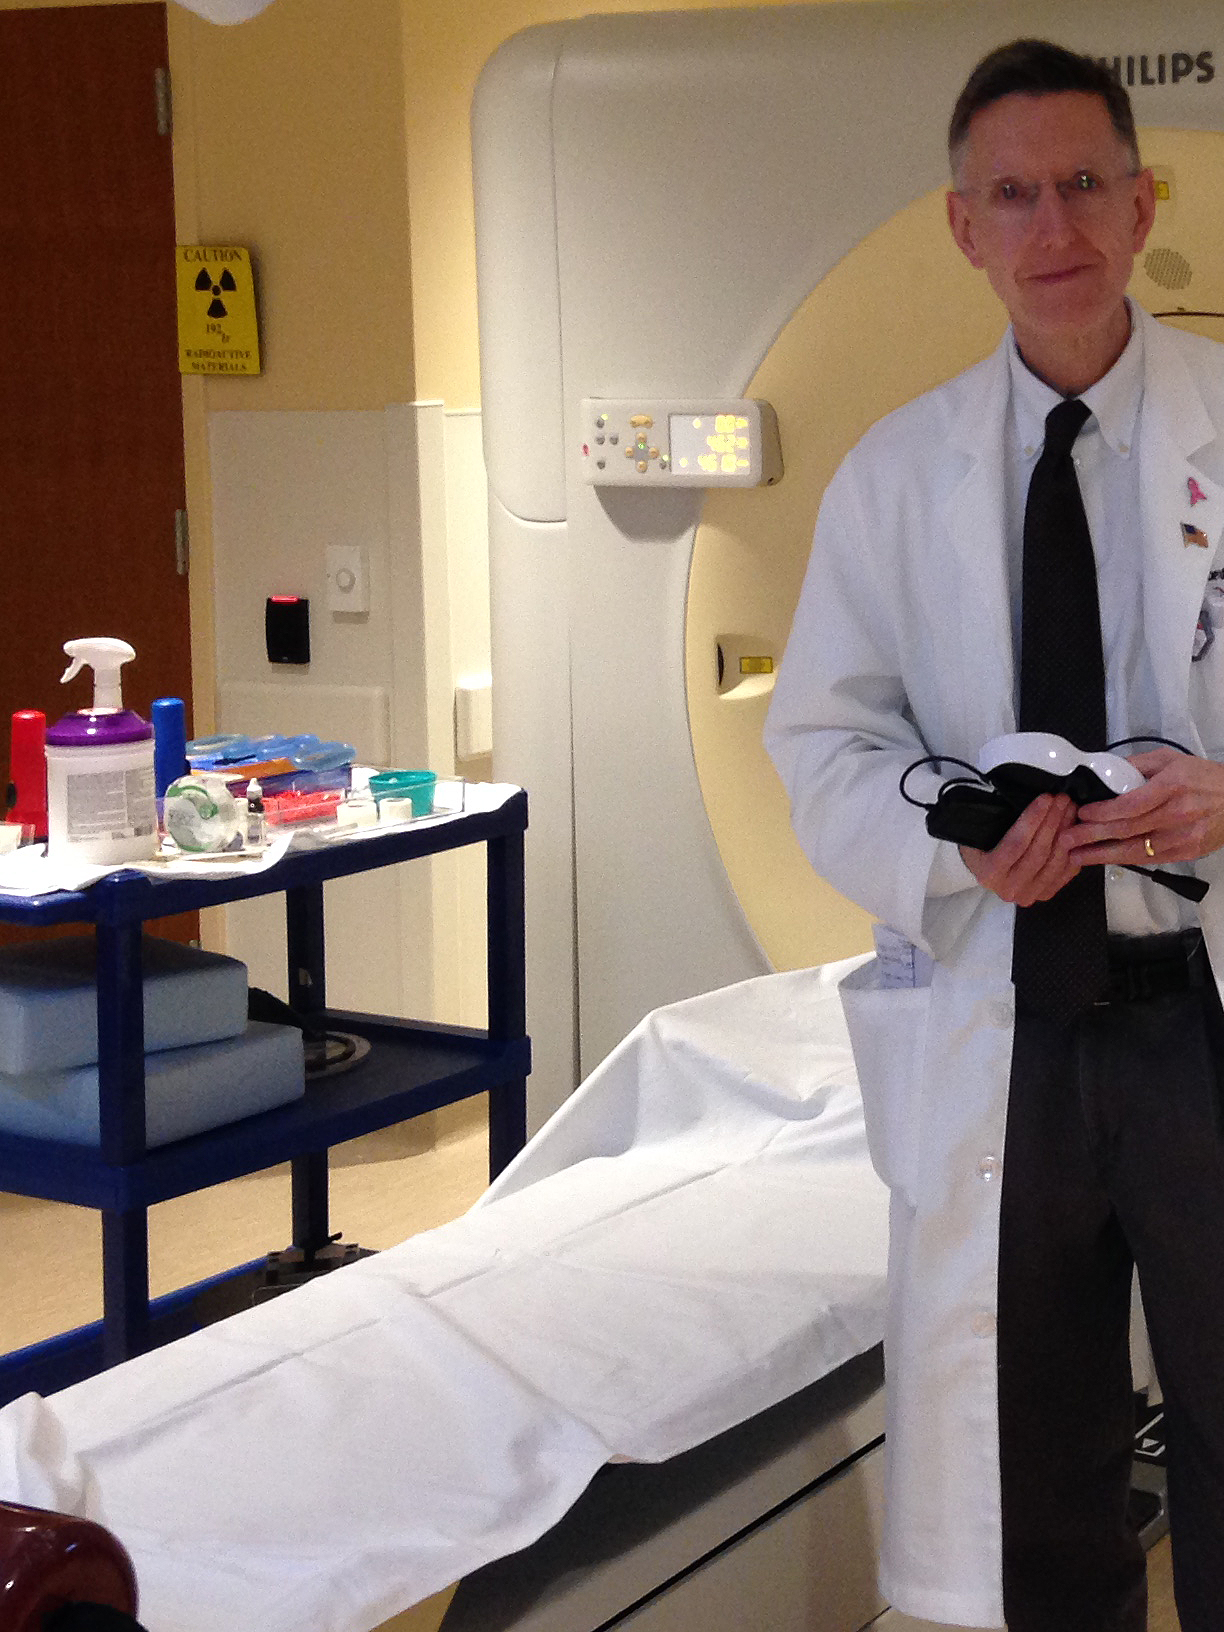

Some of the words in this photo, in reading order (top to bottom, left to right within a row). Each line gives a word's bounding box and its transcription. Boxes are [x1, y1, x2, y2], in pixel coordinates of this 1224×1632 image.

[1100, 50, 1215, 87] HILIPS
[183, 248, 242, 262] CAUTION
[185, 349, 252, 359] RADIOACTIVE
[191, 361, 247, 371] MATERIALS
